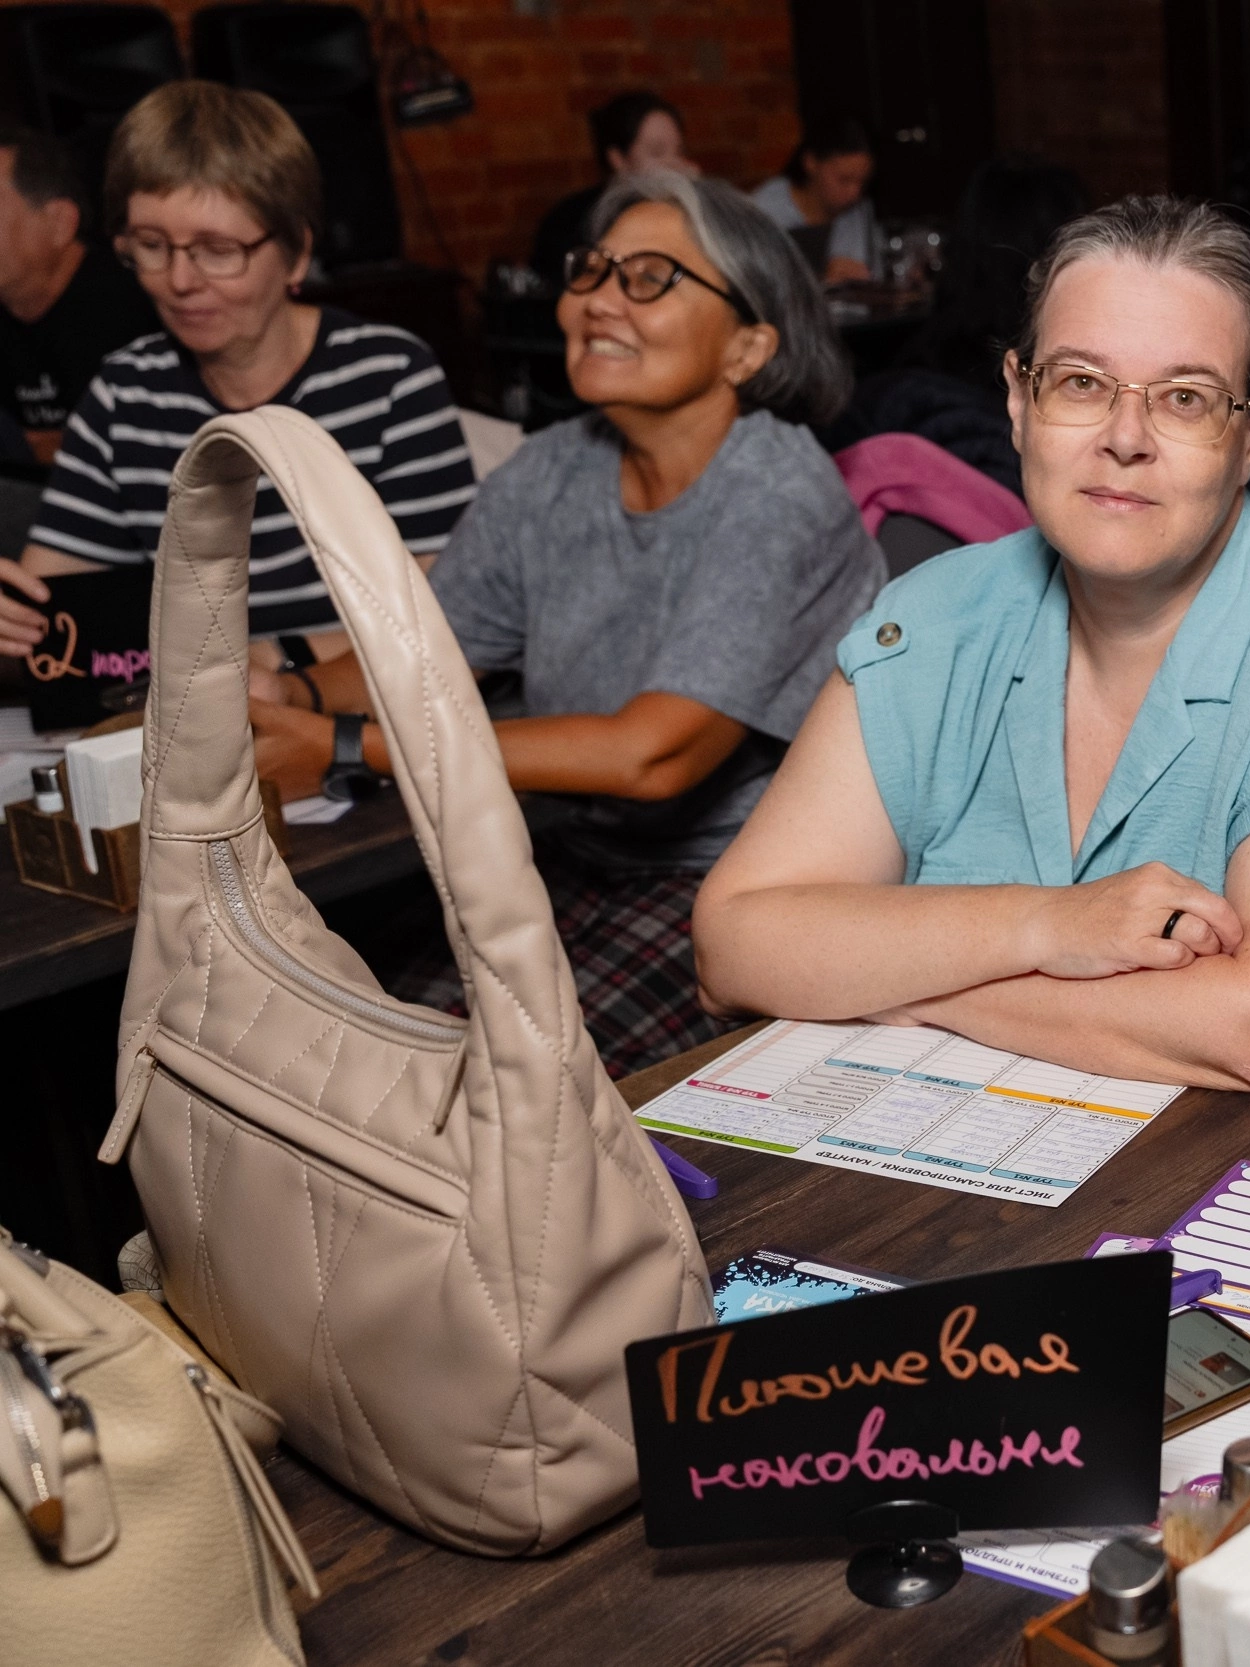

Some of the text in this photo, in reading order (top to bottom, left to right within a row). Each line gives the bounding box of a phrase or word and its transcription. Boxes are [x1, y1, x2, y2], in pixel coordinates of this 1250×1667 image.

[862, 1063, 881, 1073] ТУР
[941, 1078, 961, 1088] ТУР
[1067, 1101, 1087, 1110] ТУР
[1114, 1118, 1139, 1127] ИТОГО
[716, 1134, 735, 1142] ТУР
[839, 1139, 878, 1152] ТУР №3
[815, 1149, 871, 1167] КАУНТЕР
[923, 1154, 964, 1169] ТУР №2
[881, 1161, 985, 1188] САМОПРОВЕРКИ
[1013, 1172, 1054, 1186] ТУР №1
[986, 1181, 1017, 1194] ДЛЯ
[1015, 1187, 1055, 1201] ЛИСТ
[657, 1304, 1081, 1422] Плюшевая
[689, 1405, 1084, 1500] наковальня
[1027, 1565, 1079, 1586] ОТЗЫВЫ
